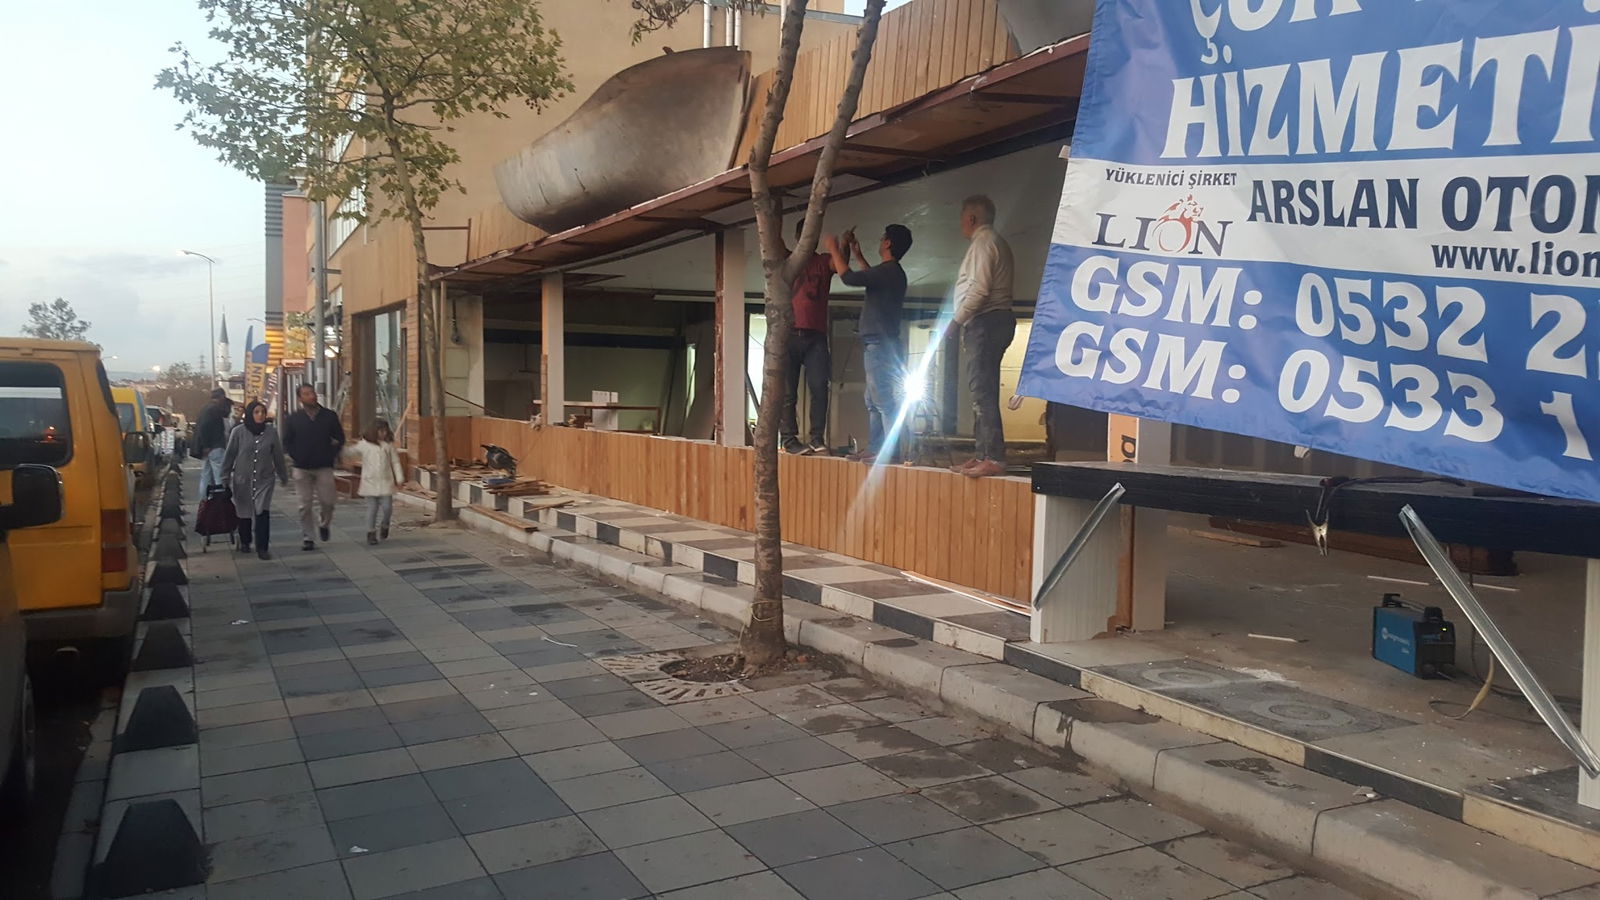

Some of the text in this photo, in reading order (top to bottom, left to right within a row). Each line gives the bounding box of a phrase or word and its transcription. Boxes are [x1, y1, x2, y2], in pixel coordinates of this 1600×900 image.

[1105, 168, 1237, 189] YÜKLENİCİ ŞİRKET
[1247, 178, 1419, 229] ARSLAN
[1092, 212, 1233, 256] LION
[1070, 255, 1263, 330] GSM:
[1295, 272, 1488, 363] 0532
[1055, 321, 1247, 404] GSM:
[1278, 349, 1504, 443] 0533
